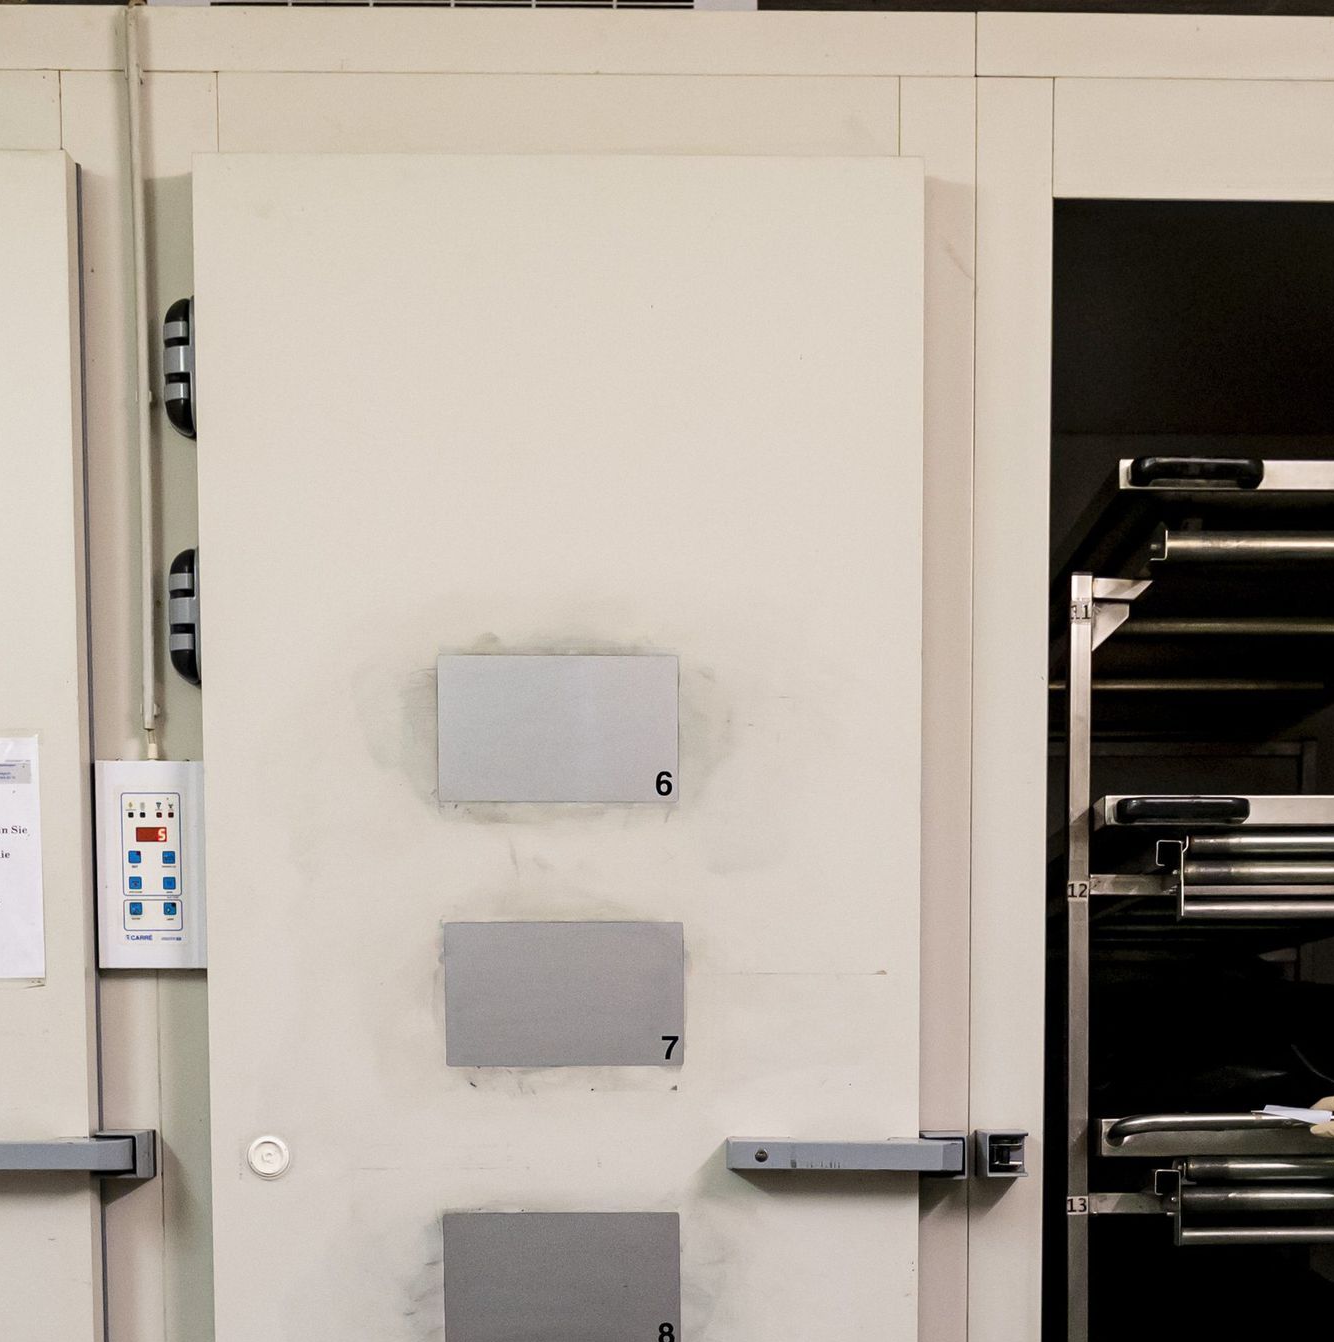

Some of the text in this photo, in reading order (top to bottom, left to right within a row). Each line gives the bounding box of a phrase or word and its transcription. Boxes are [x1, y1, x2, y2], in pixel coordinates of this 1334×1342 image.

[655, 771, 673, 796] 6
[11, 825, 28, 834] Sie
[1067, 883, 1088, 898] 12
[661, 1035, 679, 1060] 7
[1067, 1197, 1087, 1213] 13
